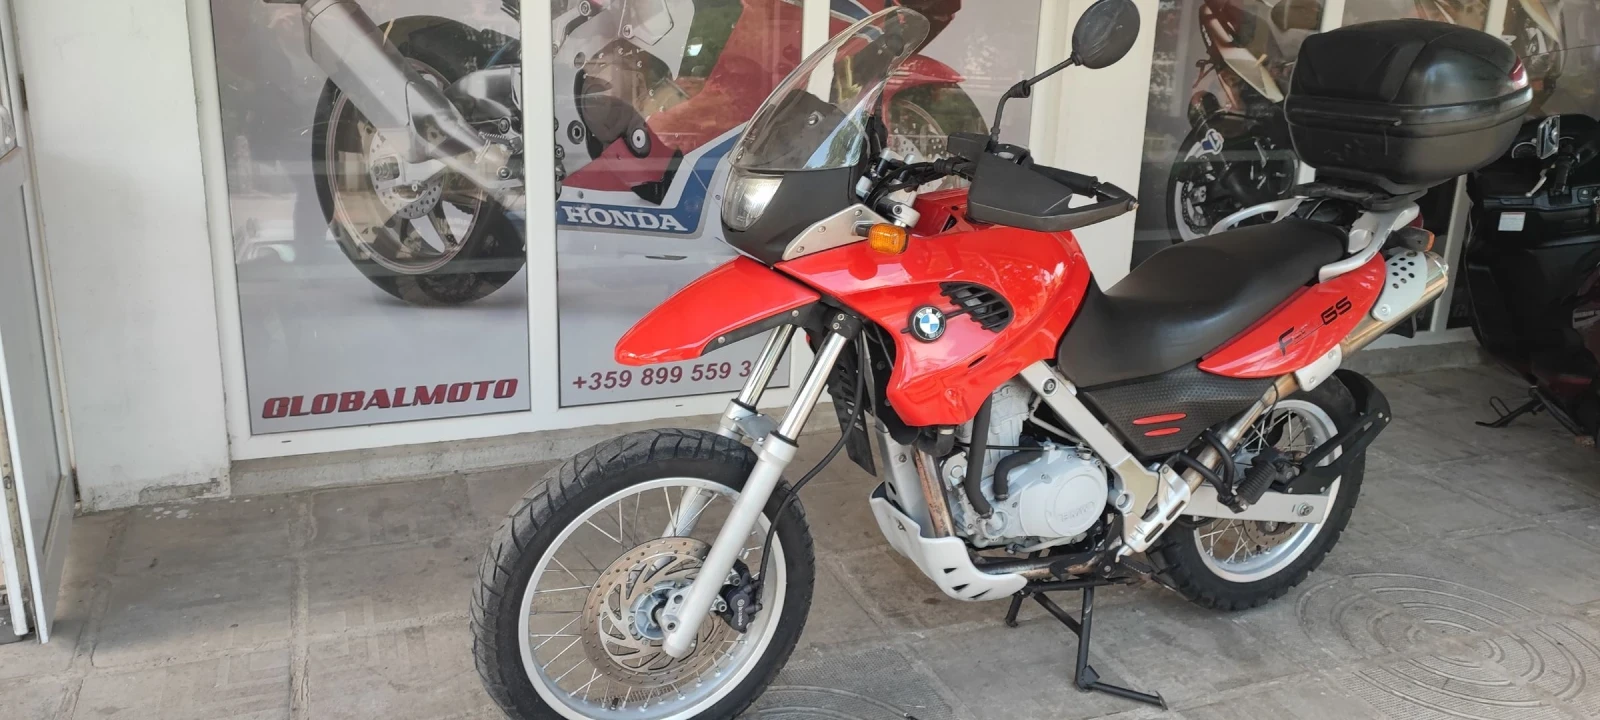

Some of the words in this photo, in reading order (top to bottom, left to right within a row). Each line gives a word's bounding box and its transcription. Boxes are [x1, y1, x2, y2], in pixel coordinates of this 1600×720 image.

[561, 205, 688, 231] HONDA
[1321, 296, 1352, 325] GS
[572, 369, 633, 391] +359
[640, 365, 683, 386] 899
[690, 361, 732, 382] 559
[261, 378, 518, 419] GLOBALMOTO
